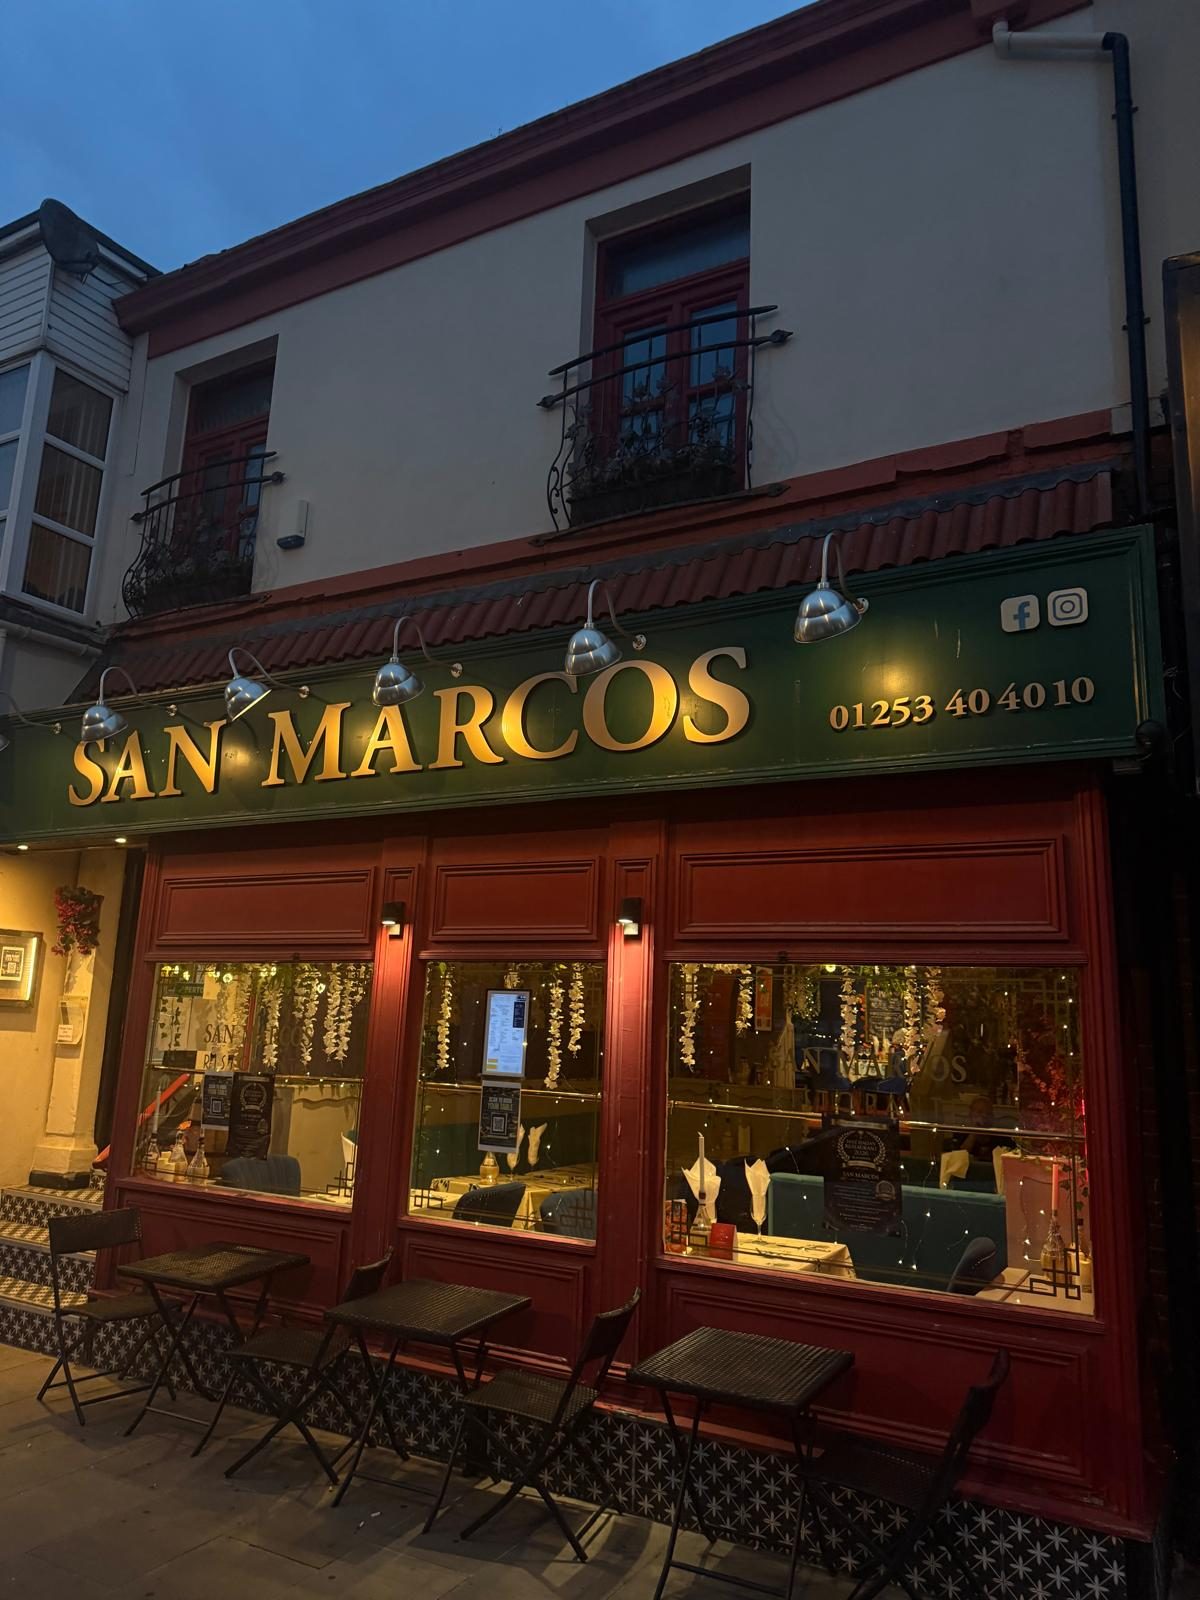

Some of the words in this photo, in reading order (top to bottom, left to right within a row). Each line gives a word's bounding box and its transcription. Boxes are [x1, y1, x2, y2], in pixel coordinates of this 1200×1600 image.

[68, 719, 227, 806] SAN
[261, 646, 750, 787] MARCOS
[829, 695, 934, 730] 01253
[204, 1023, 236, 1044] SAN
